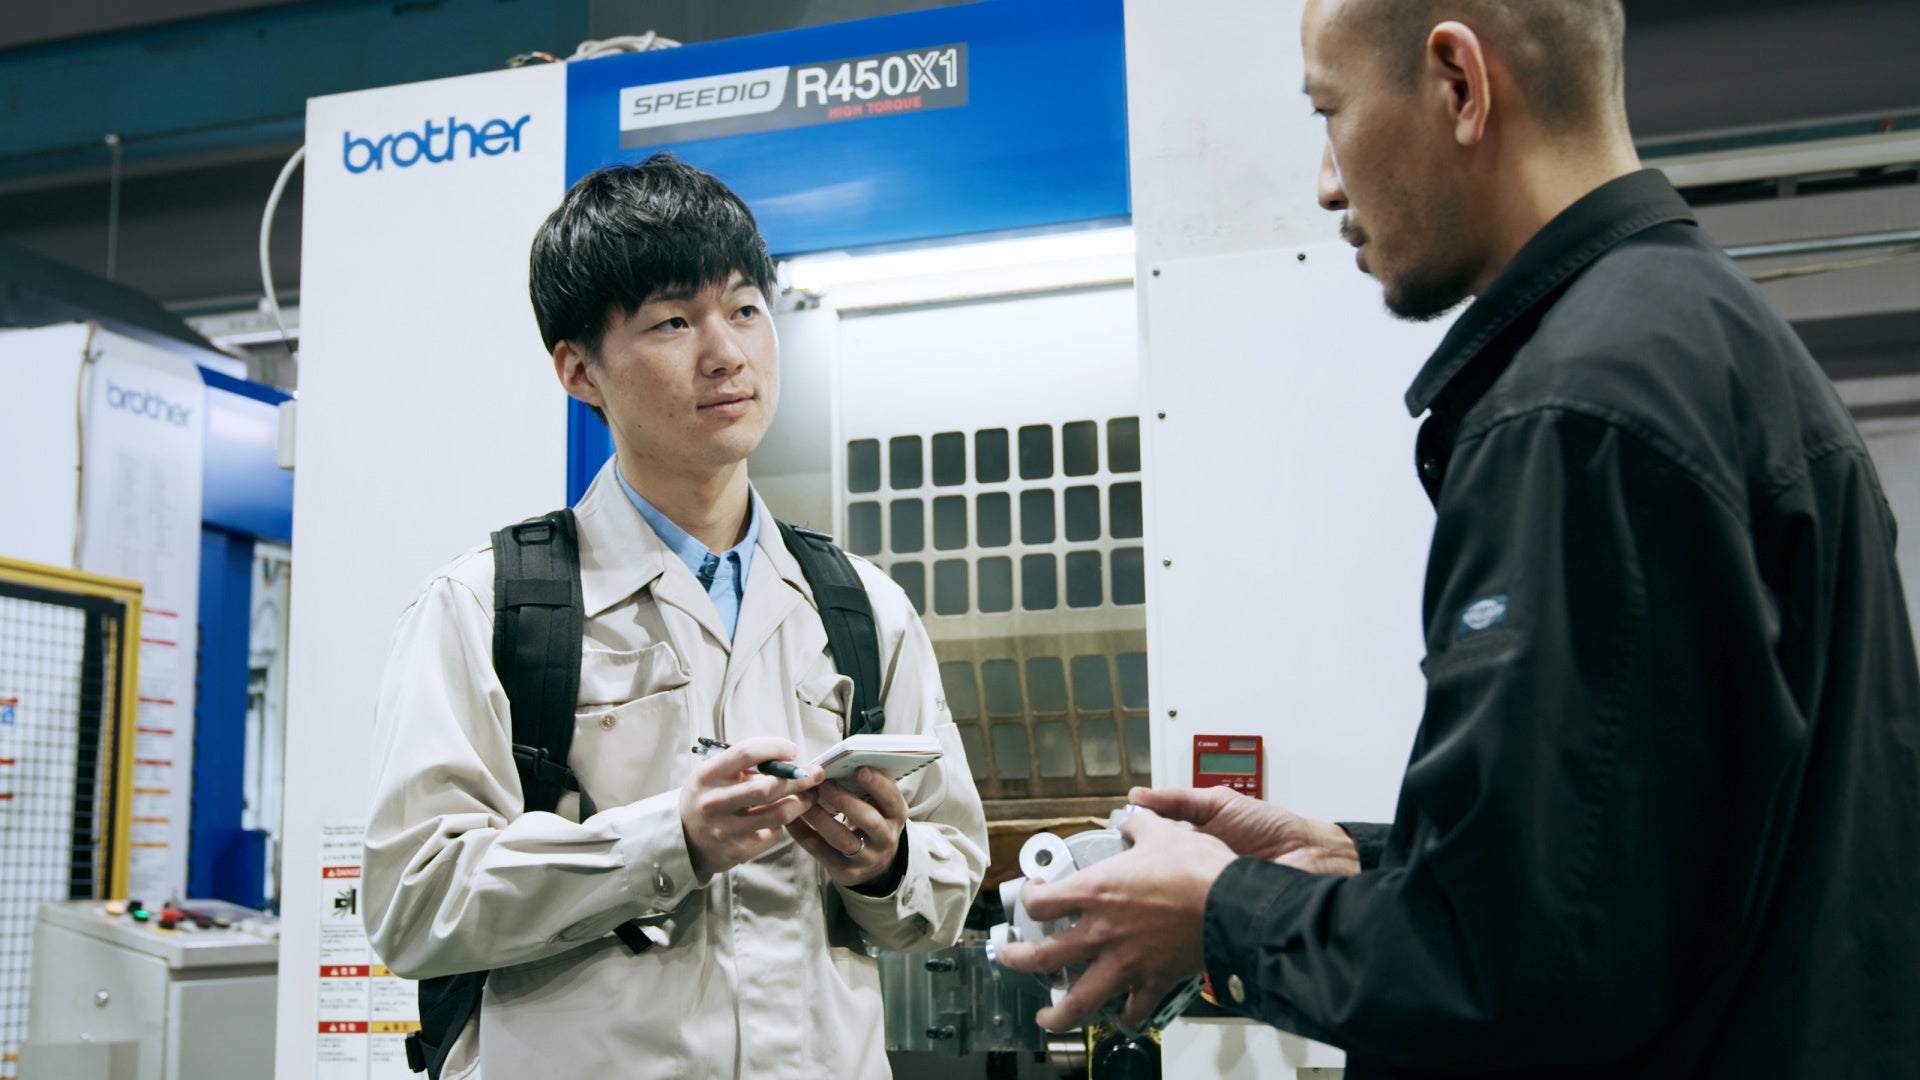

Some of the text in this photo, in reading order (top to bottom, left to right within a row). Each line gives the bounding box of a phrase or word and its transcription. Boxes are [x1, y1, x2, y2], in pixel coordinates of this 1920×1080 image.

[633, 48, 958, 116] SPEEDIO R450X1
[828, 96, 922, 119] HIGH TORQUE
[343, 114, 531, 174] brother
[106, 379, 193, 427] brother
